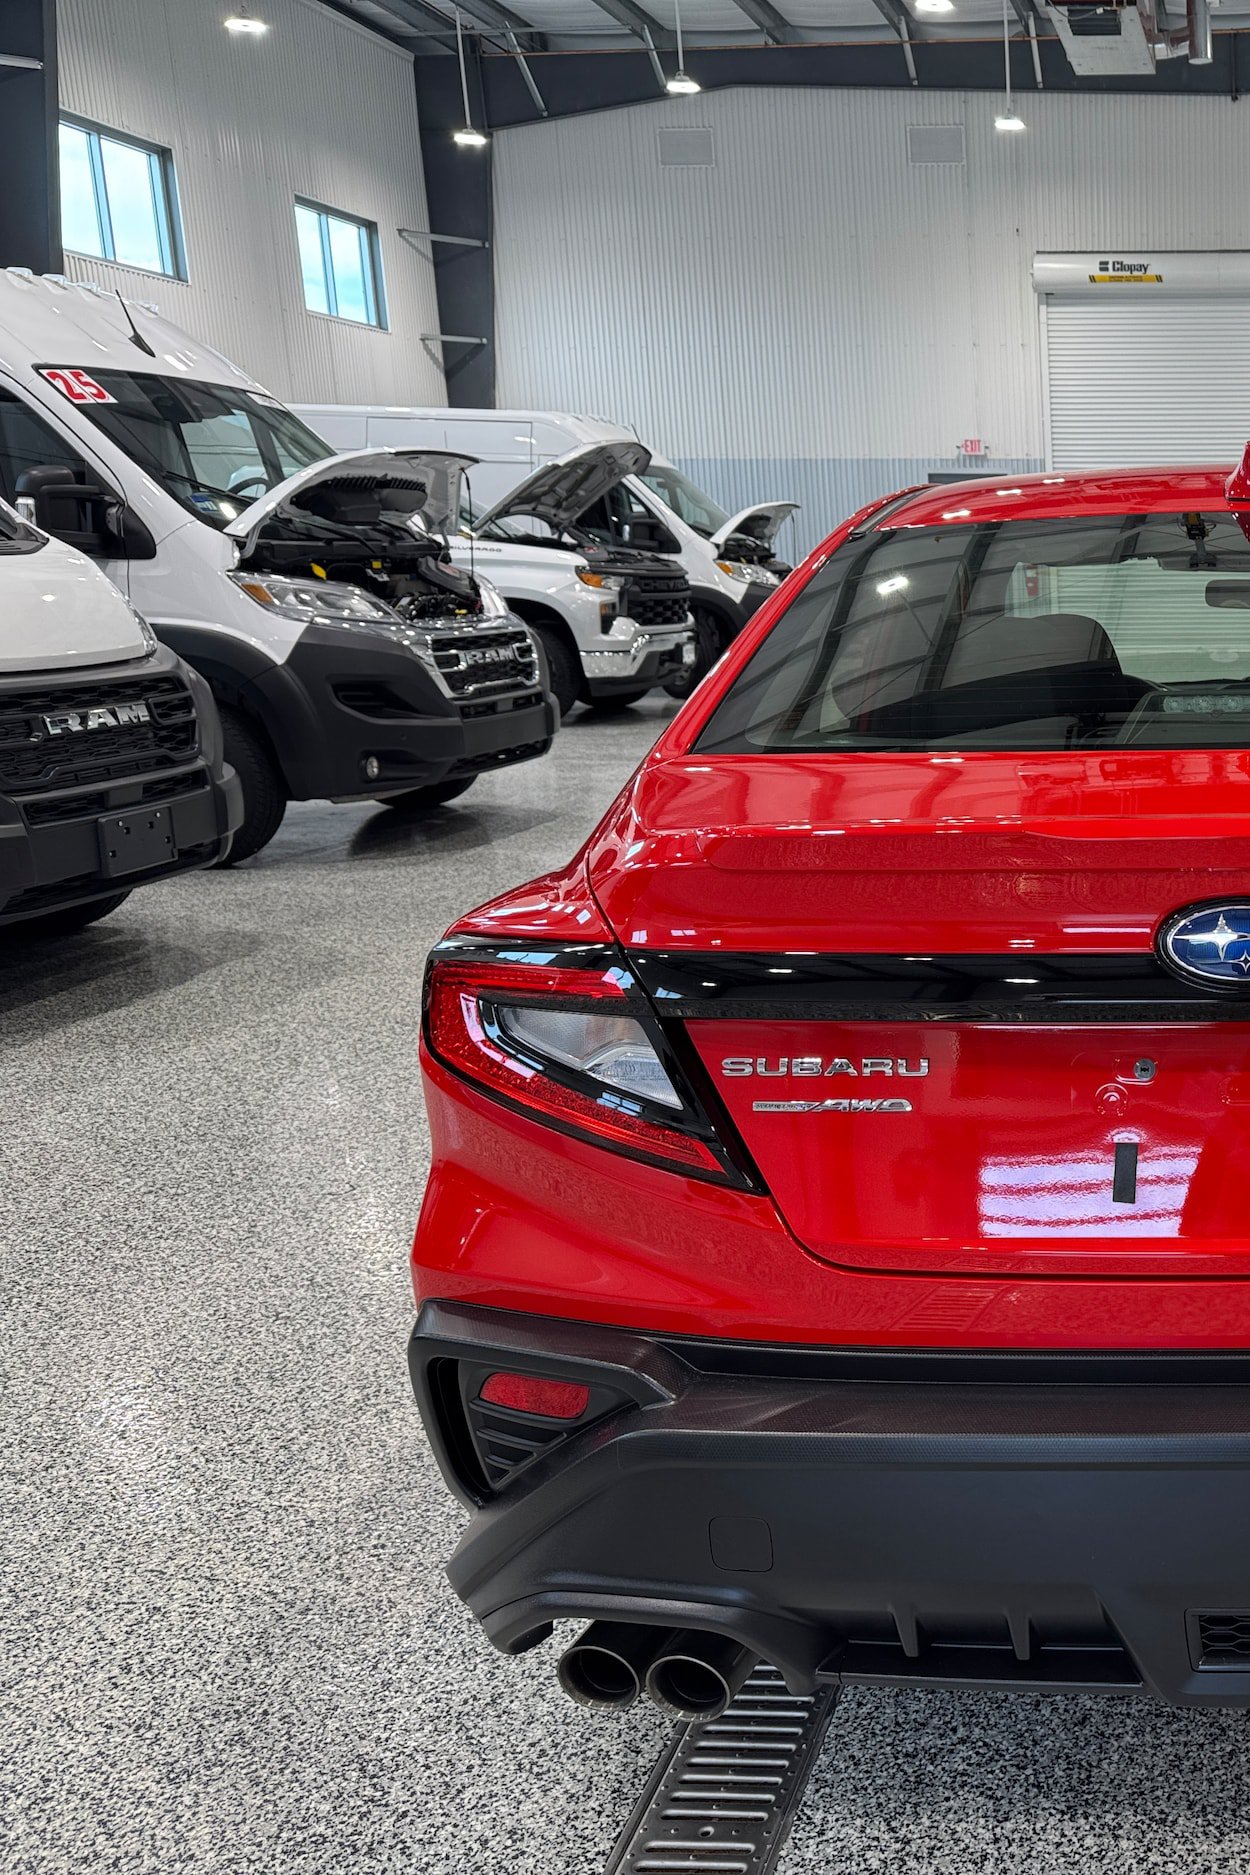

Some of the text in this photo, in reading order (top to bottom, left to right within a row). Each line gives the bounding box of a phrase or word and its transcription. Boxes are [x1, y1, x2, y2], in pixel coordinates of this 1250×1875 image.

[1112, 261, 1148, 275] Clopay
[46, 371, 107, 400] 25
[965, 439, 981, 453] EXIT
[463, 645, 516, 665] RAM
[43, 701, 150, 735] RAM
[721, 1056, 930, 1077] SUBARU
[816, 1098, 913, 1112] AWD
